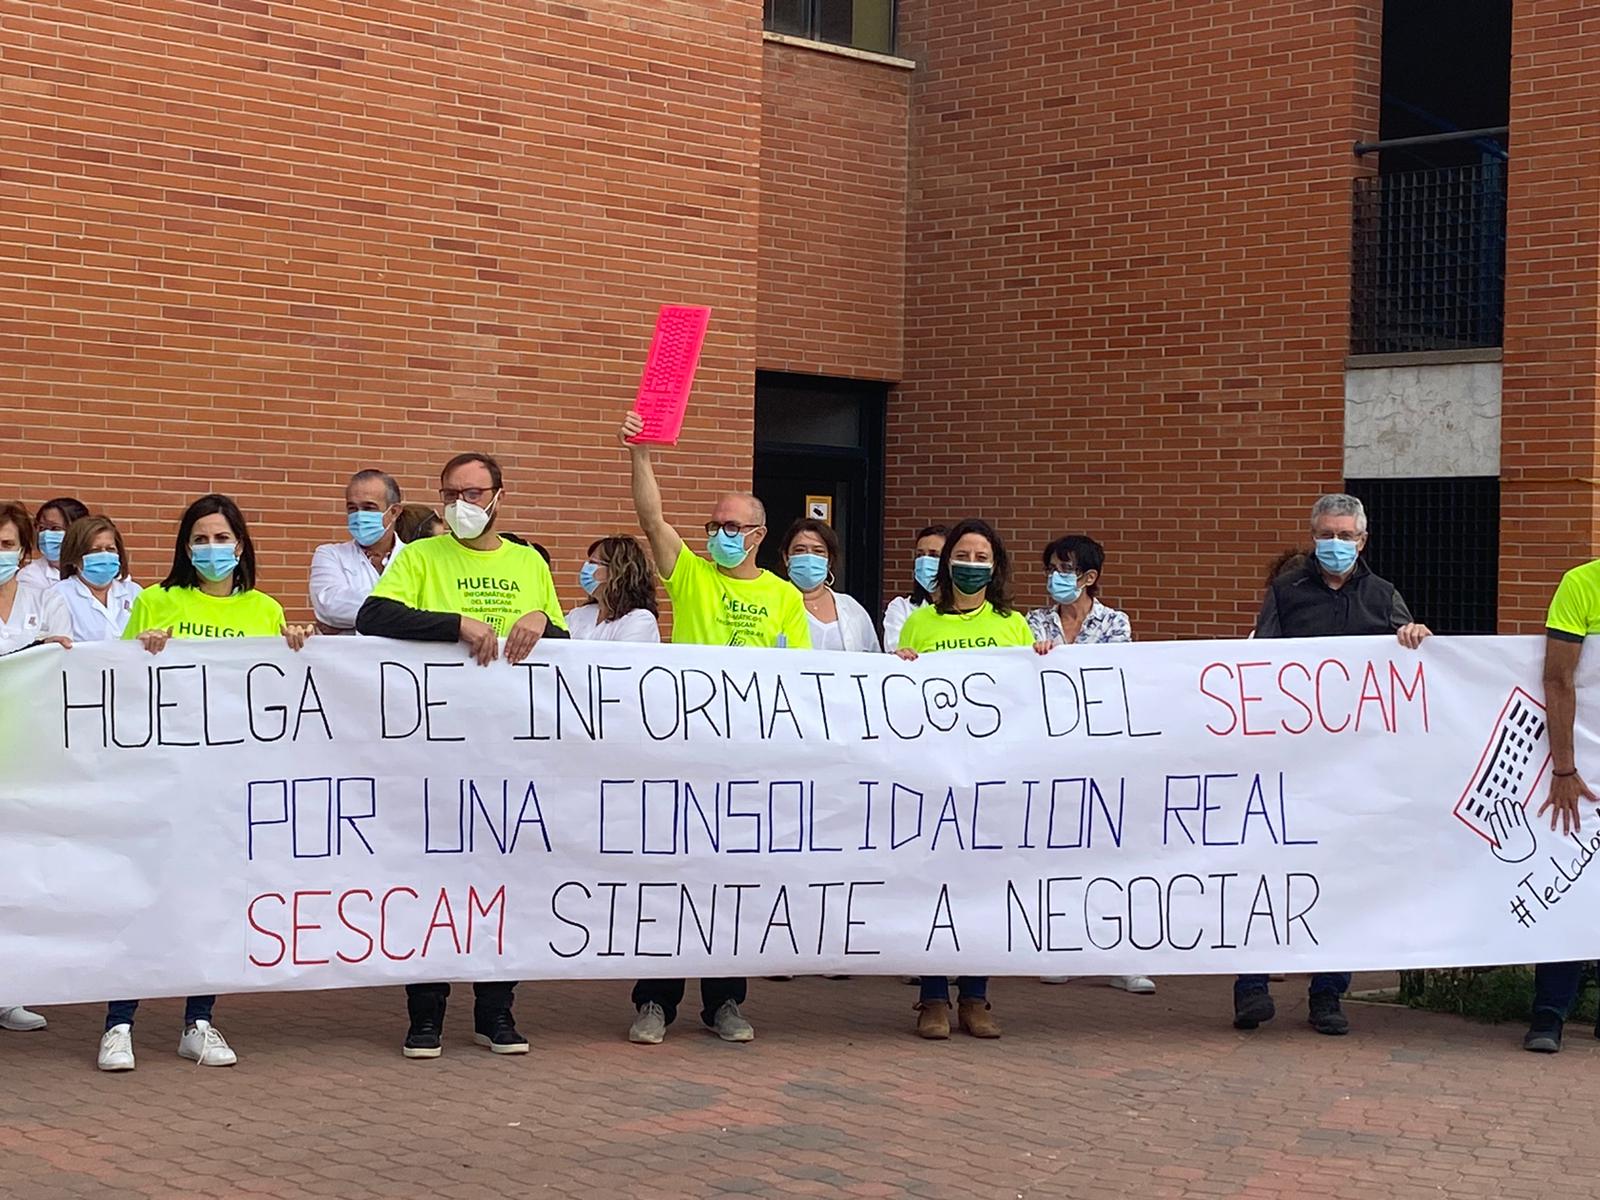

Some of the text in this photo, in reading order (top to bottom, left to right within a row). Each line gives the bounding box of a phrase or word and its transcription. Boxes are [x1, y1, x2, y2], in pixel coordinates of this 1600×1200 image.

[457, 577, 520, 592] HUELGA
[179, 621, 246, 638] HUELGA
[935, 637, 998, 650] HUELGA
[62, 659, 1428, 748] HUELGA DE INFORMATIC@S DEL SESCAM
[248, 772, 1318, 860] POR UNA CONSOLIDACION REAL
[248, 873, 1319, 967] SESCAM SIENTATE A NEGOCIAR
[1510, 826, 1600, 928] #Teclado
